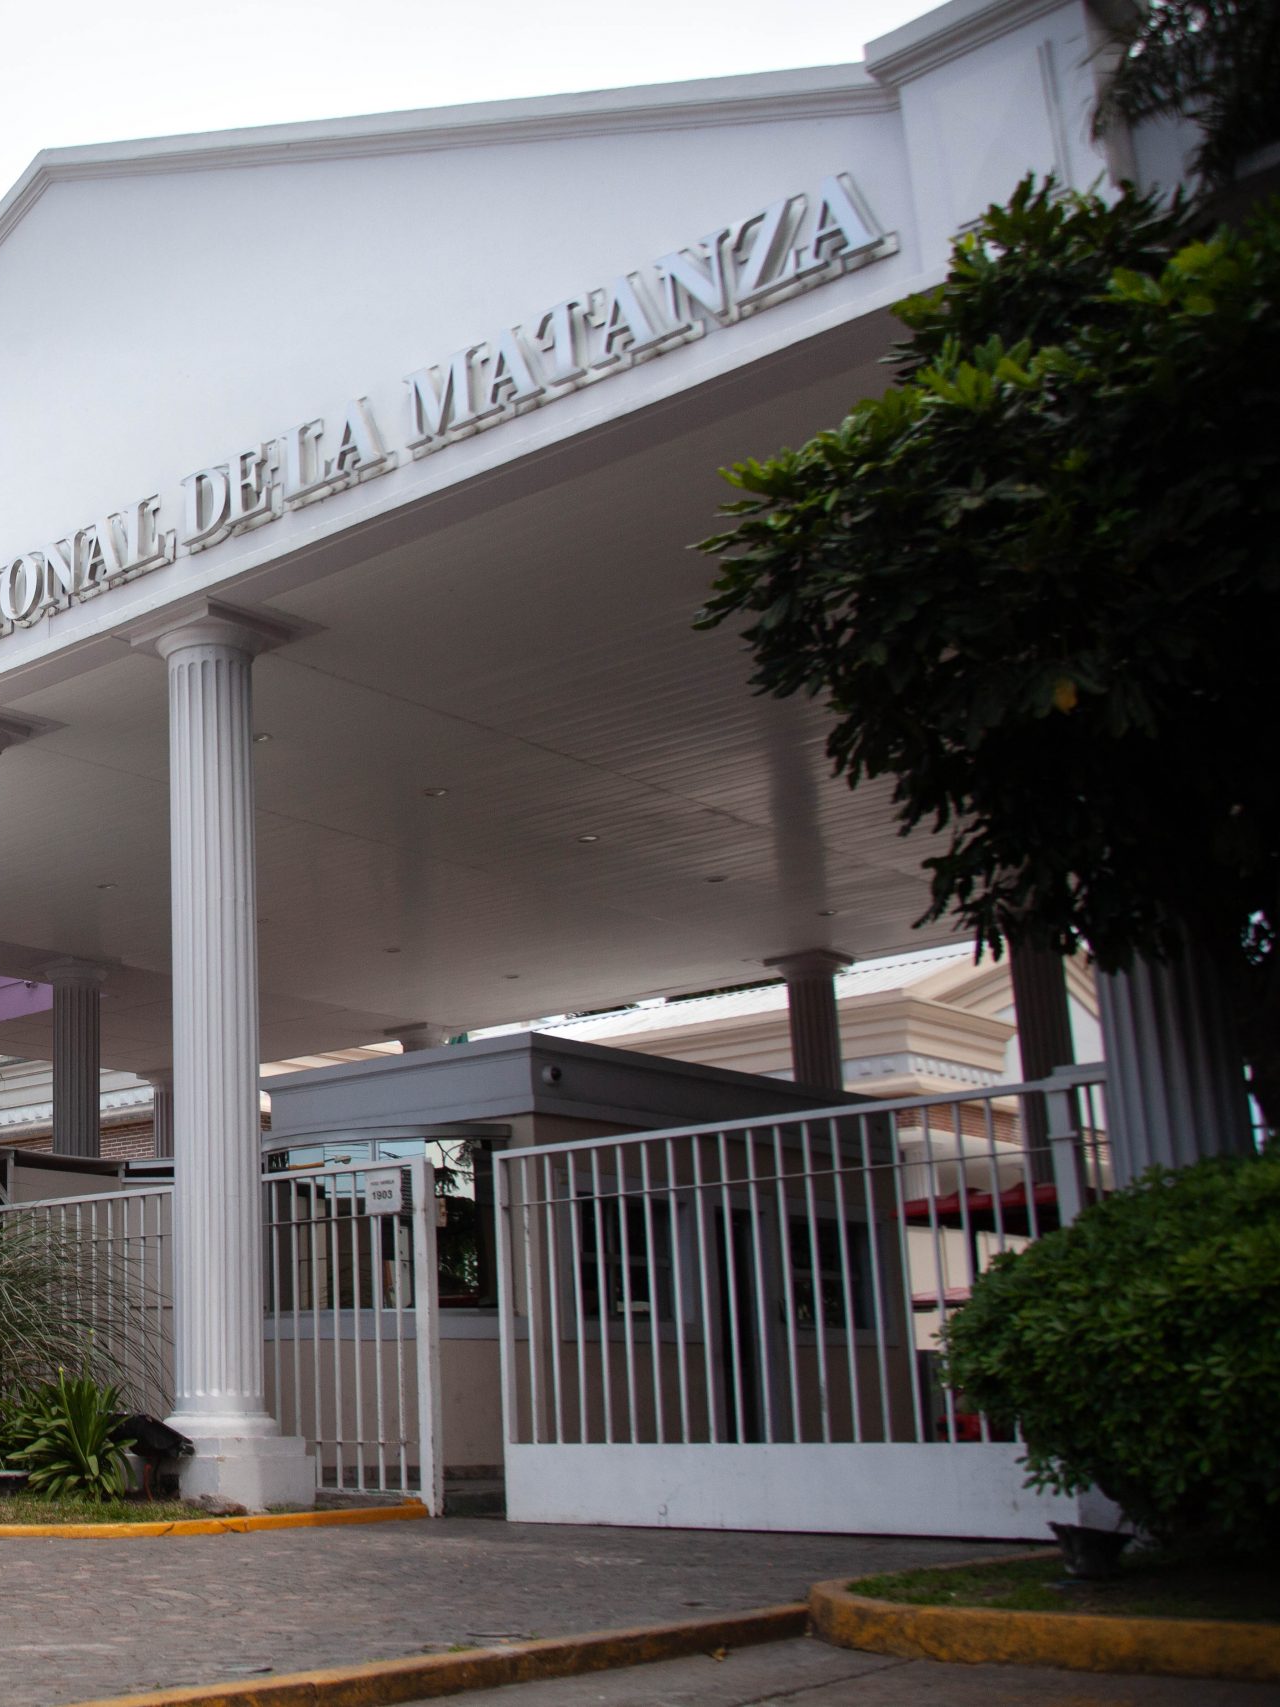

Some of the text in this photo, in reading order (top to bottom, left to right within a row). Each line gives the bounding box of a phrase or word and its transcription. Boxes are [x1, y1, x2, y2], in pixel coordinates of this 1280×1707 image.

[180, 436, 285, 556] DE
[276, 392, 398, 512] LA
[403, 171, 901, 460] MATANZA
[372, 1190, 393, 1200] 1903
